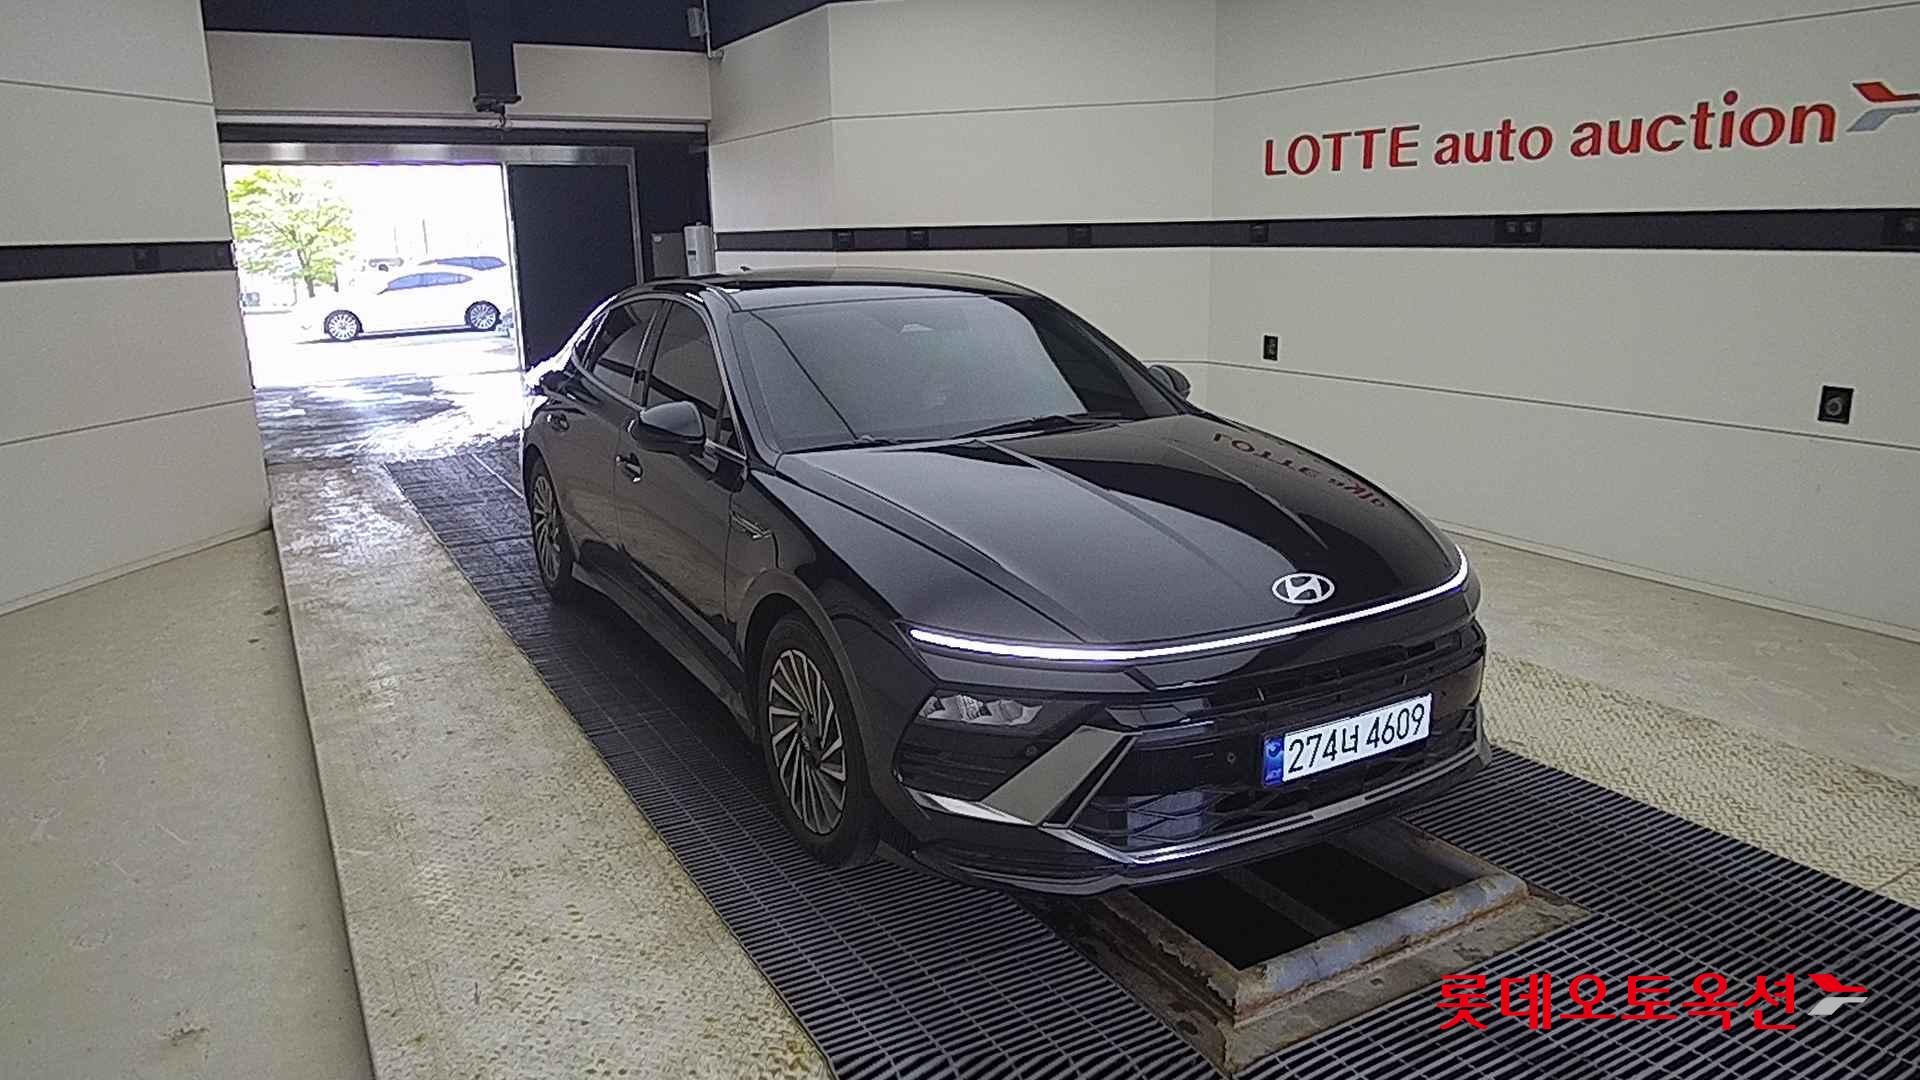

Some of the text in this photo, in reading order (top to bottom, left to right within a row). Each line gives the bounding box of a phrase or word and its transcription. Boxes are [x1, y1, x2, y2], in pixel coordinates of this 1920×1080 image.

[1264, 90, 1837, 177] LOTTE auto auction
[1288, 703, 1425, 773] 274너 4609
